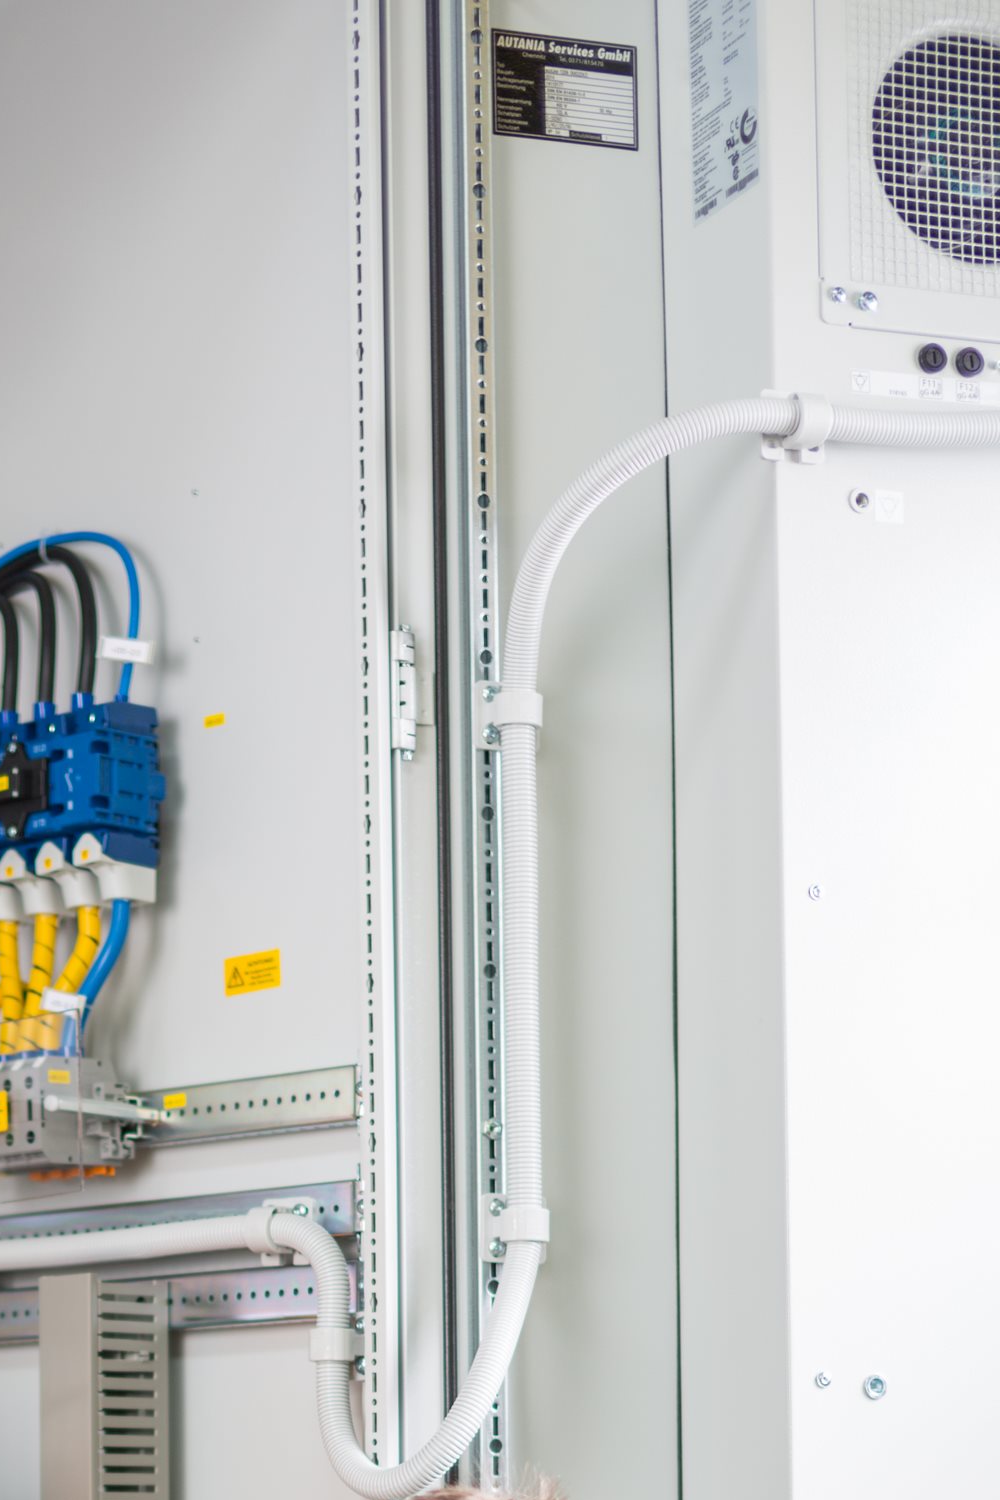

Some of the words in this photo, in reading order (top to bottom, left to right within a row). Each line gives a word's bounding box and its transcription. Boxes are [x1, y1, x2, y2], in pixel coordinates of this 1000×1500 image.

[497, 35, 545, 52] AUTANIA
[548, 42, 594, 58] Services
[597, 48, 631, 63] GmbH
[922, 379, 936, 388] F11
